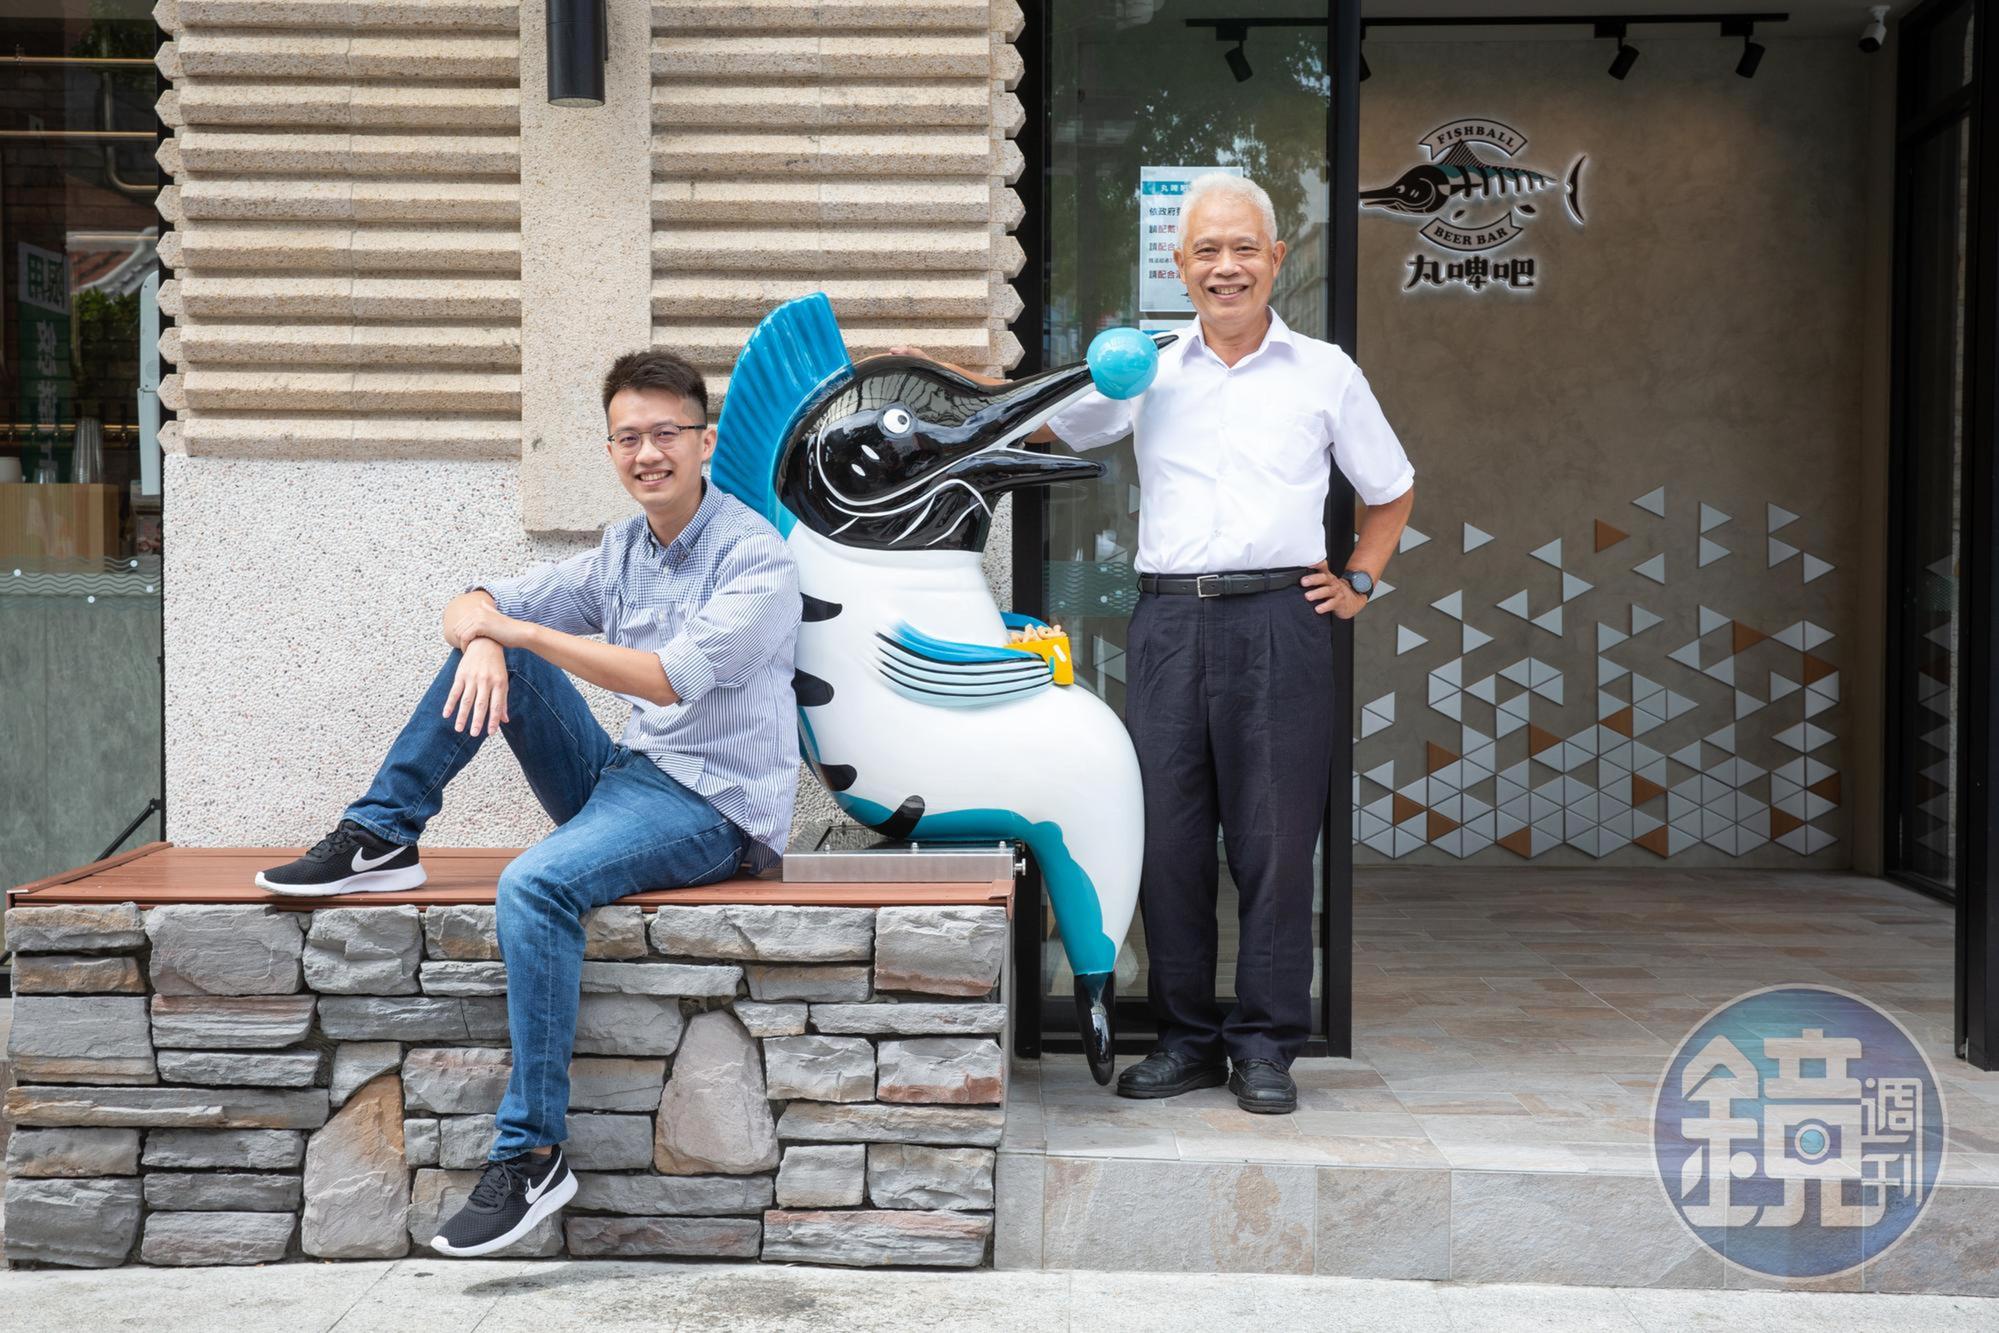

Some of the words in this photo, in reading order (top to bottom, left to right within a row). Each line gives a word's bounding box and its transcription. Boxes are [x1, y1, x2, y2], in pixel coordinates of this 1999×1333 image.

[1436, 126, 1514, 148] FISHBALL
[1433, 226, 1473, 246] BEER
[1476, 227, 1509, 246] BAR
[1405, 254, 1535, 290] 丸啤吧
